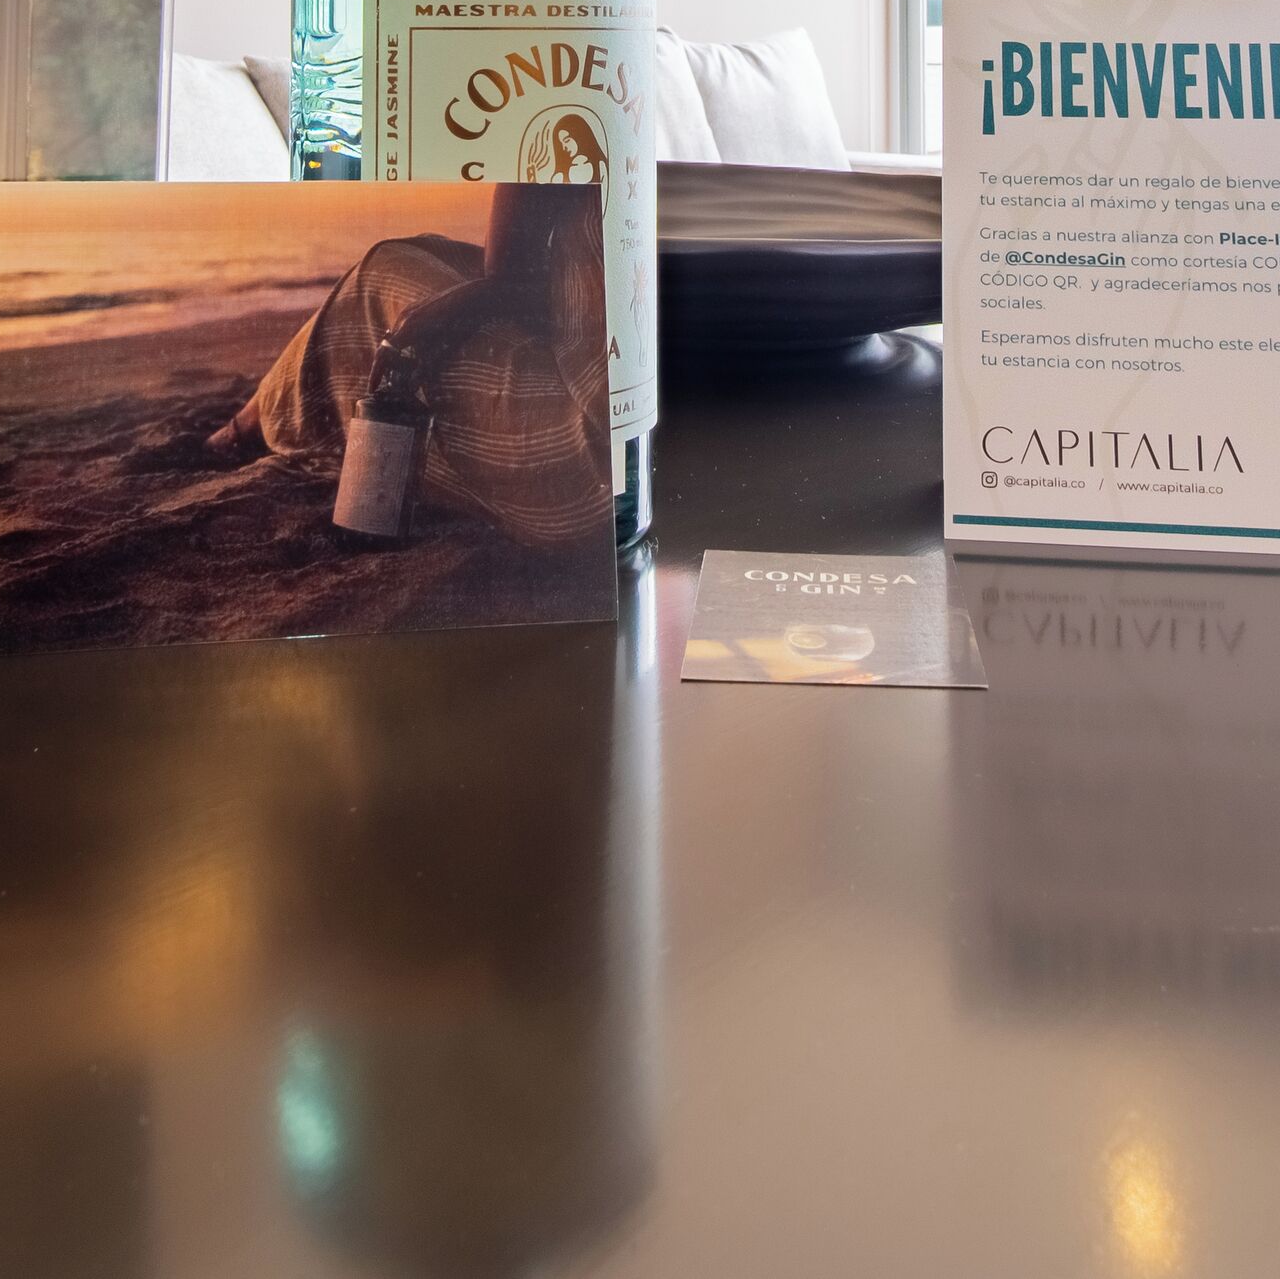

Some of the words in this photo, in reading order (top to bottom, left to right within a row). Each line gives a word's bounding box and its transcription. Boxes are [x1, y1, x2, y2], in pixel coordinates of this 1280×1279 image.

[415, 4, 537, 17] MAESTRA
[547, 5, 654, 18] DESTILA
[387, 34, 399, 140] JASMINE
[444, 43, 646, 140] CONDESA
[980, 172, 997, 184] Te
[1002, 175, 1083, 188] queremos
[1087, 175, 1113, 187] dar
[1119, 178, 1140, 187] un
[1145, 175, 1195, 190] regalo
[1200, 175, 1221, 188] de
[980, 195, 996, 205] tu
[1001, 195, 1066, 207] estancia
[1072, 196, 1084, 208] al
[1090, 196, 1156, 209] máximo
[1162, 200, 1170, 212] y
[1175, 198, 1229, 212] tengas
[1234, 200, 1266, 212] una
[980, 227, 1037, 241] Gracias
[1042, 232, 1051, 241] a
[1057, 231, 1116, 242] nuestra
[1121, 231, 1178, 244] alianza
[1184, 235, 1214, 245] con
[980, 251, 1000, 263] de
[1005, 251, 1126, 268] @CondesaGin
[1131, 256, 1178, 267] como
[1183, 255, 1247, 269] cortesía
[981, 270, 1048, 287] CÓDIGO
[1053, 275, 1081, 290] QR.
[1091, 279, 1100, 291] y
[1104, 277, 1237, 293] agradeceríamos
[1242, 283, 1271, 293] nos
[981, 297, 1045, 310] sociales.
[981, 330, 1071, 347] Esperamos
[1076, 332, 1148, 348] disfruten
[1155, 336, 1214, 350] mucho
[1219, 339, 1253, 350] este
[981, 354, 997, 365] tu
[1003, 355, 1070, 368] estancia
[1075, 358, 1105, 369] con
[1111, 359, 1185, 372] nosotros.
[982, 426, 1245, 473] CAPITALIA
[1004, 476, 1086, 489] @capitalia.co
[1117, 481, 1223, 494] www.capitalia.co
[744, 570, 917, 585] CONDESA
[800, 583, 861, 595] GIN
